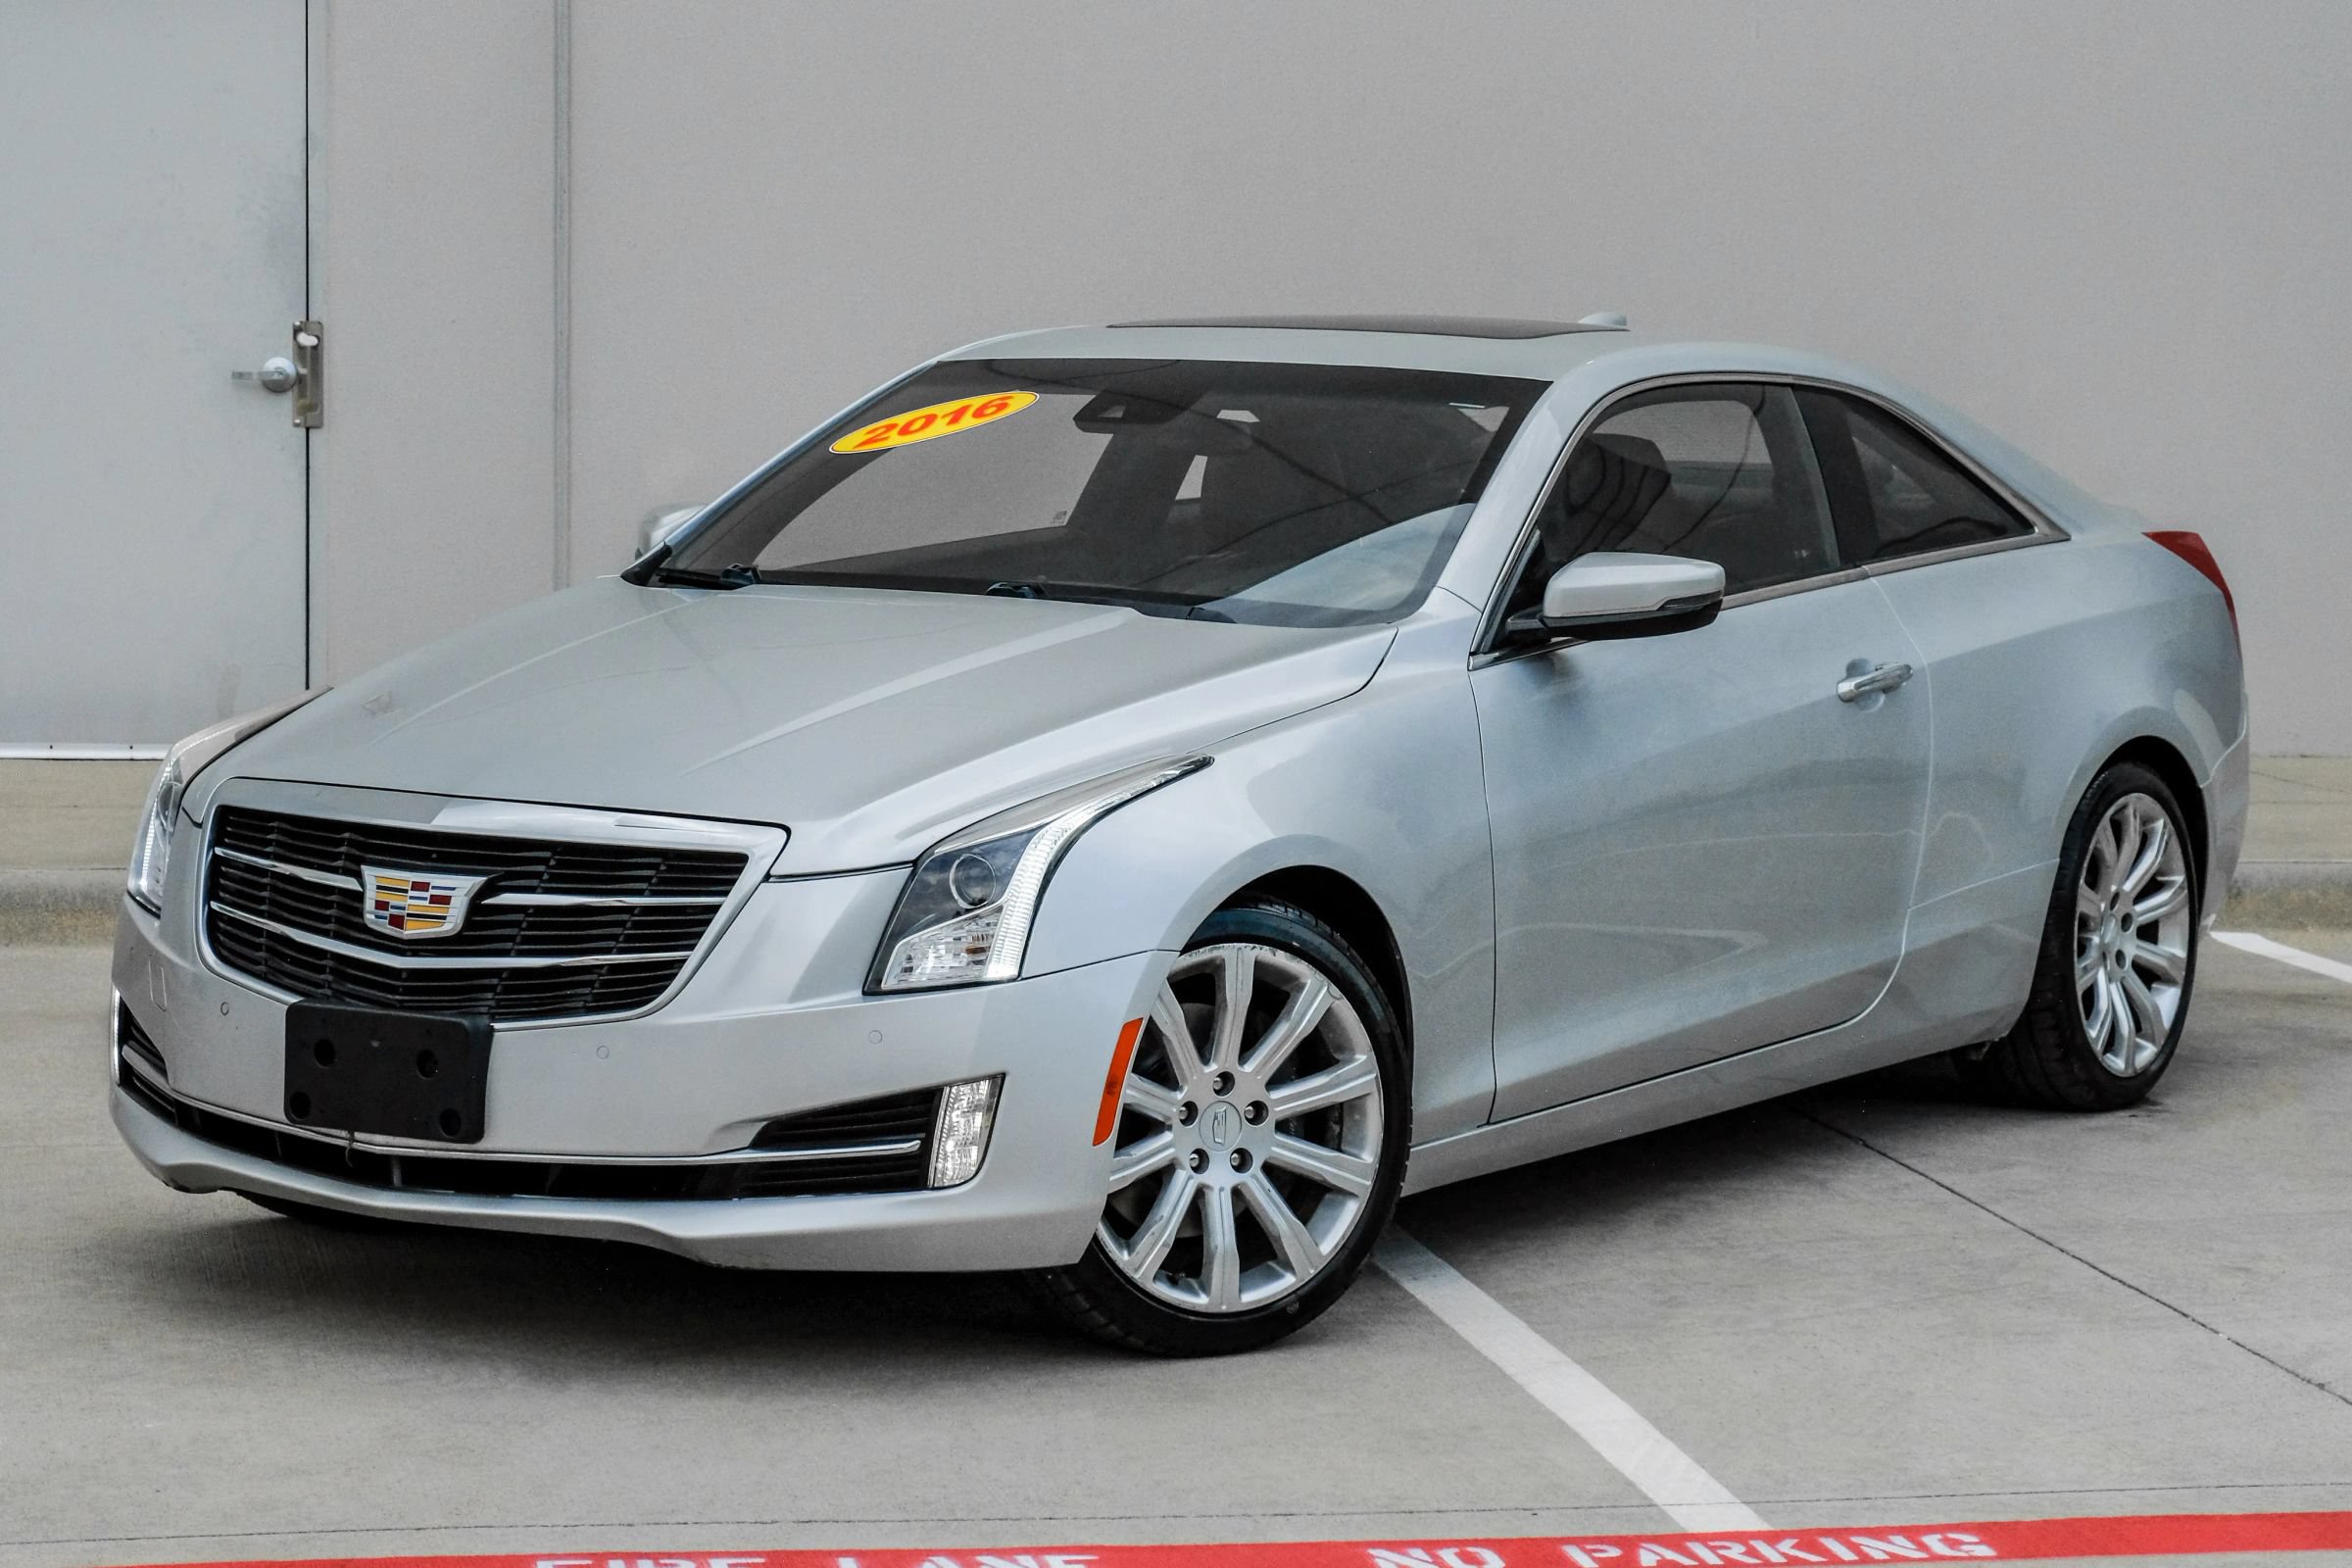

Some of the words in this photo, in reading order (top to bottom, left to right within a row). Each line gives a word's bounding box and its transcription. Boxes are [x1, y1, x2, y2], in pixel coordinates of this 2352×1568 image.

[853, 395, 1015, 450] 2016
[1366, 1546, 1506, 1568] NO
[1561, 1533, 1997, 1568] PARKING
